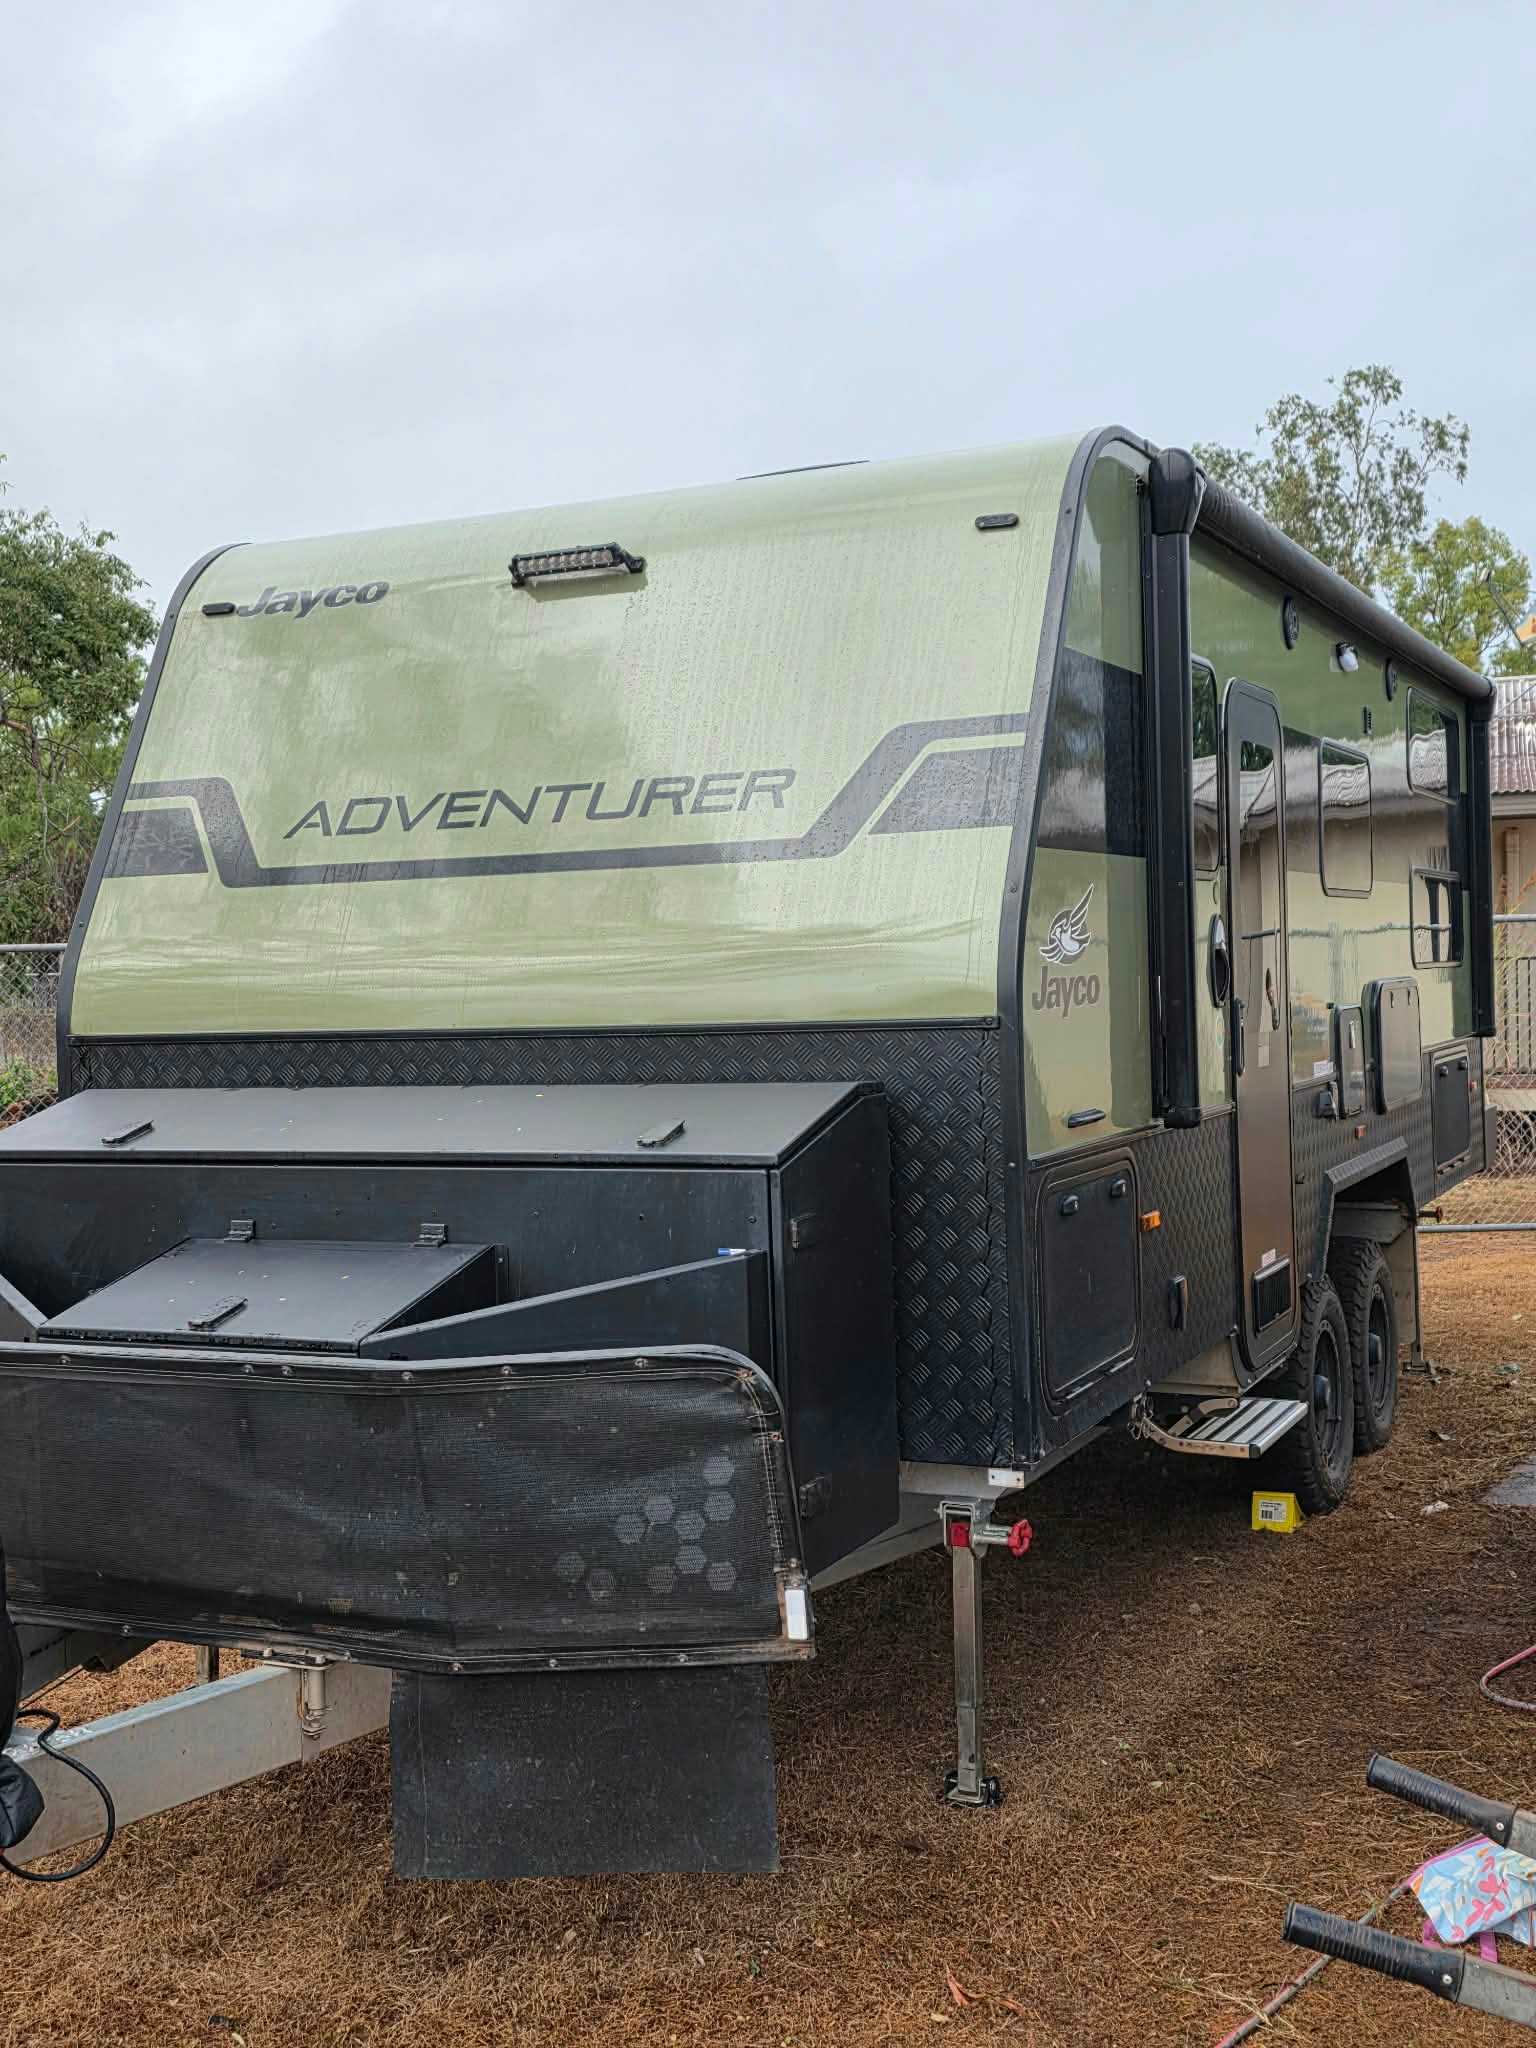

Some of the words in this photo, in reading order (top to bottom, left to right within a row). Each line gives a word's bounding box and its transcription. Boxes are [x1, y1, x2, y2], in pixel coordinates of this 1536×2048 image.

[236, 581, 390, 619] Jayco
[283, 768, 797, 840] ADVENTURER
[1032, 965, 1101, 1018] Jayco
